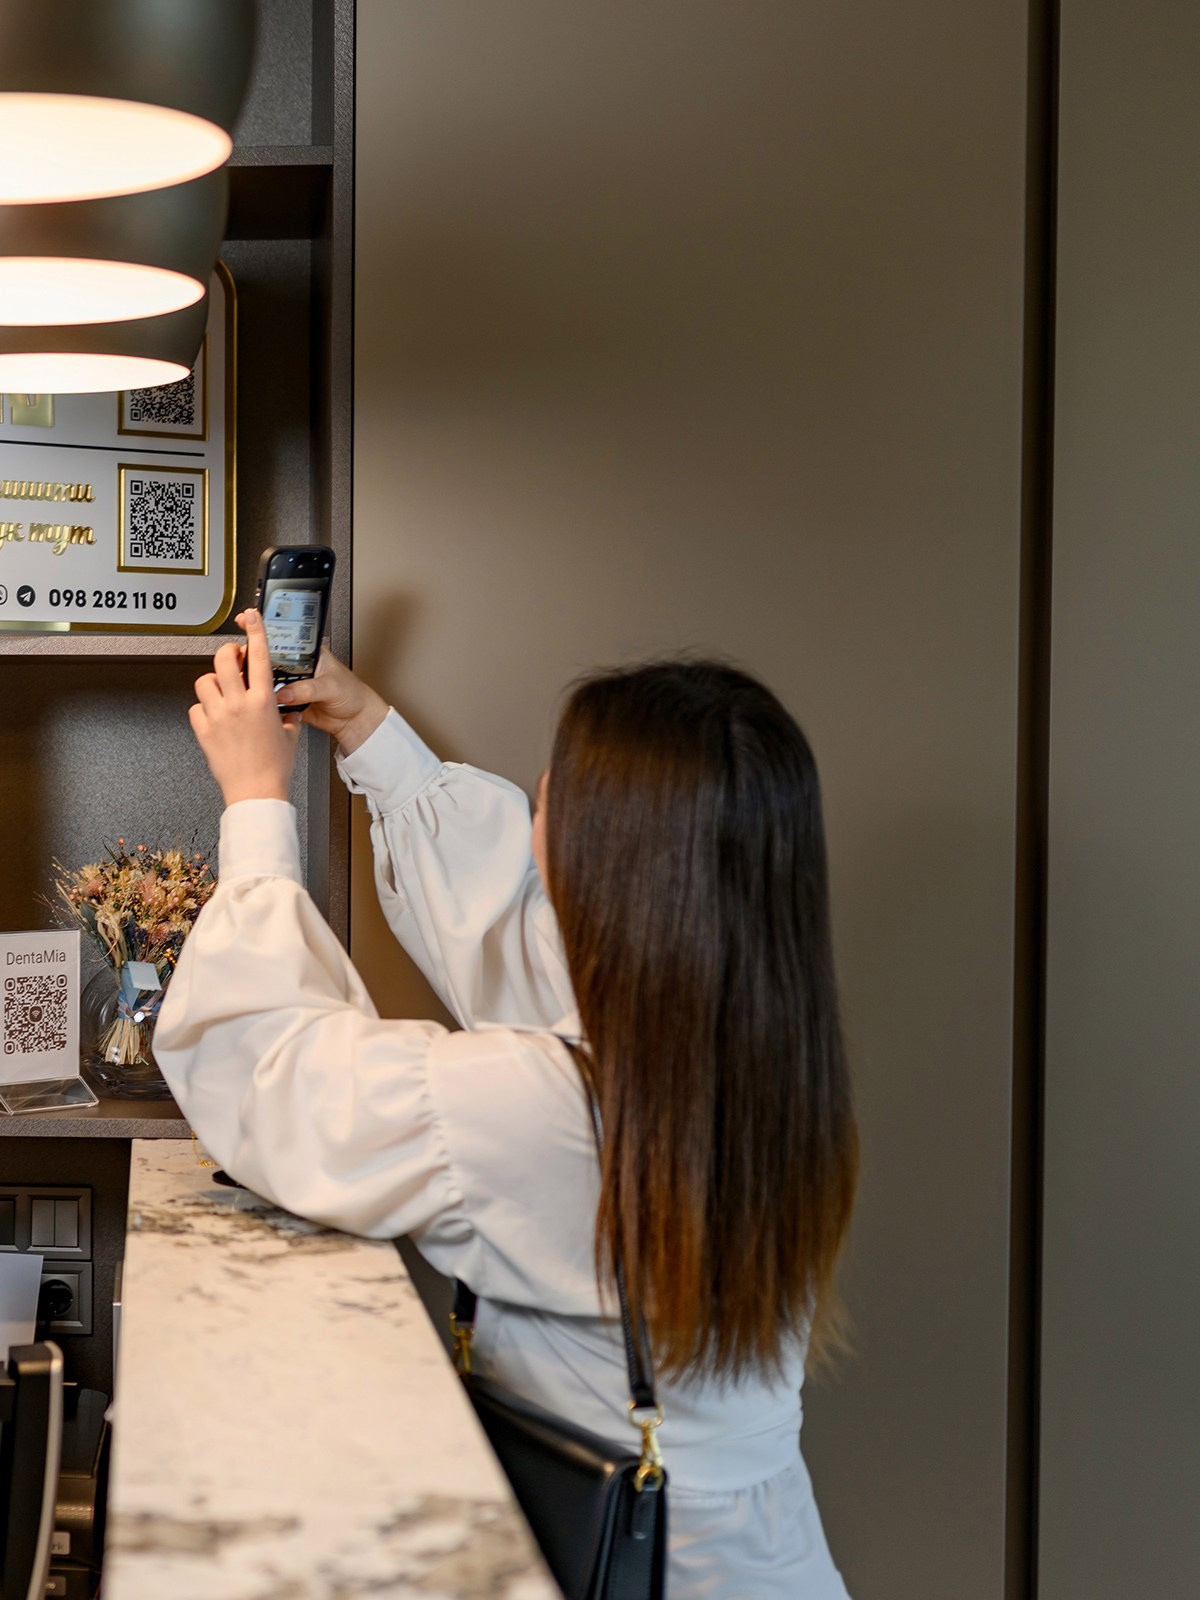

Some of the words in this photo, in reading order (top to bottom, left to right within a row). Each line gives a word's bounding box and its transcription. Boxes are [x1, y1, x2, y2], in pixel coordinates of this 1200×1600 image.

[28, 522, 97, 556] тут
[49, 588, 87, 607] 098
[92, 590, 128, 609] 282
[132, 591, 147, 609] 11
[152, 592, 177, 610] 80
[6, 949, 66, 966] DentaMia
